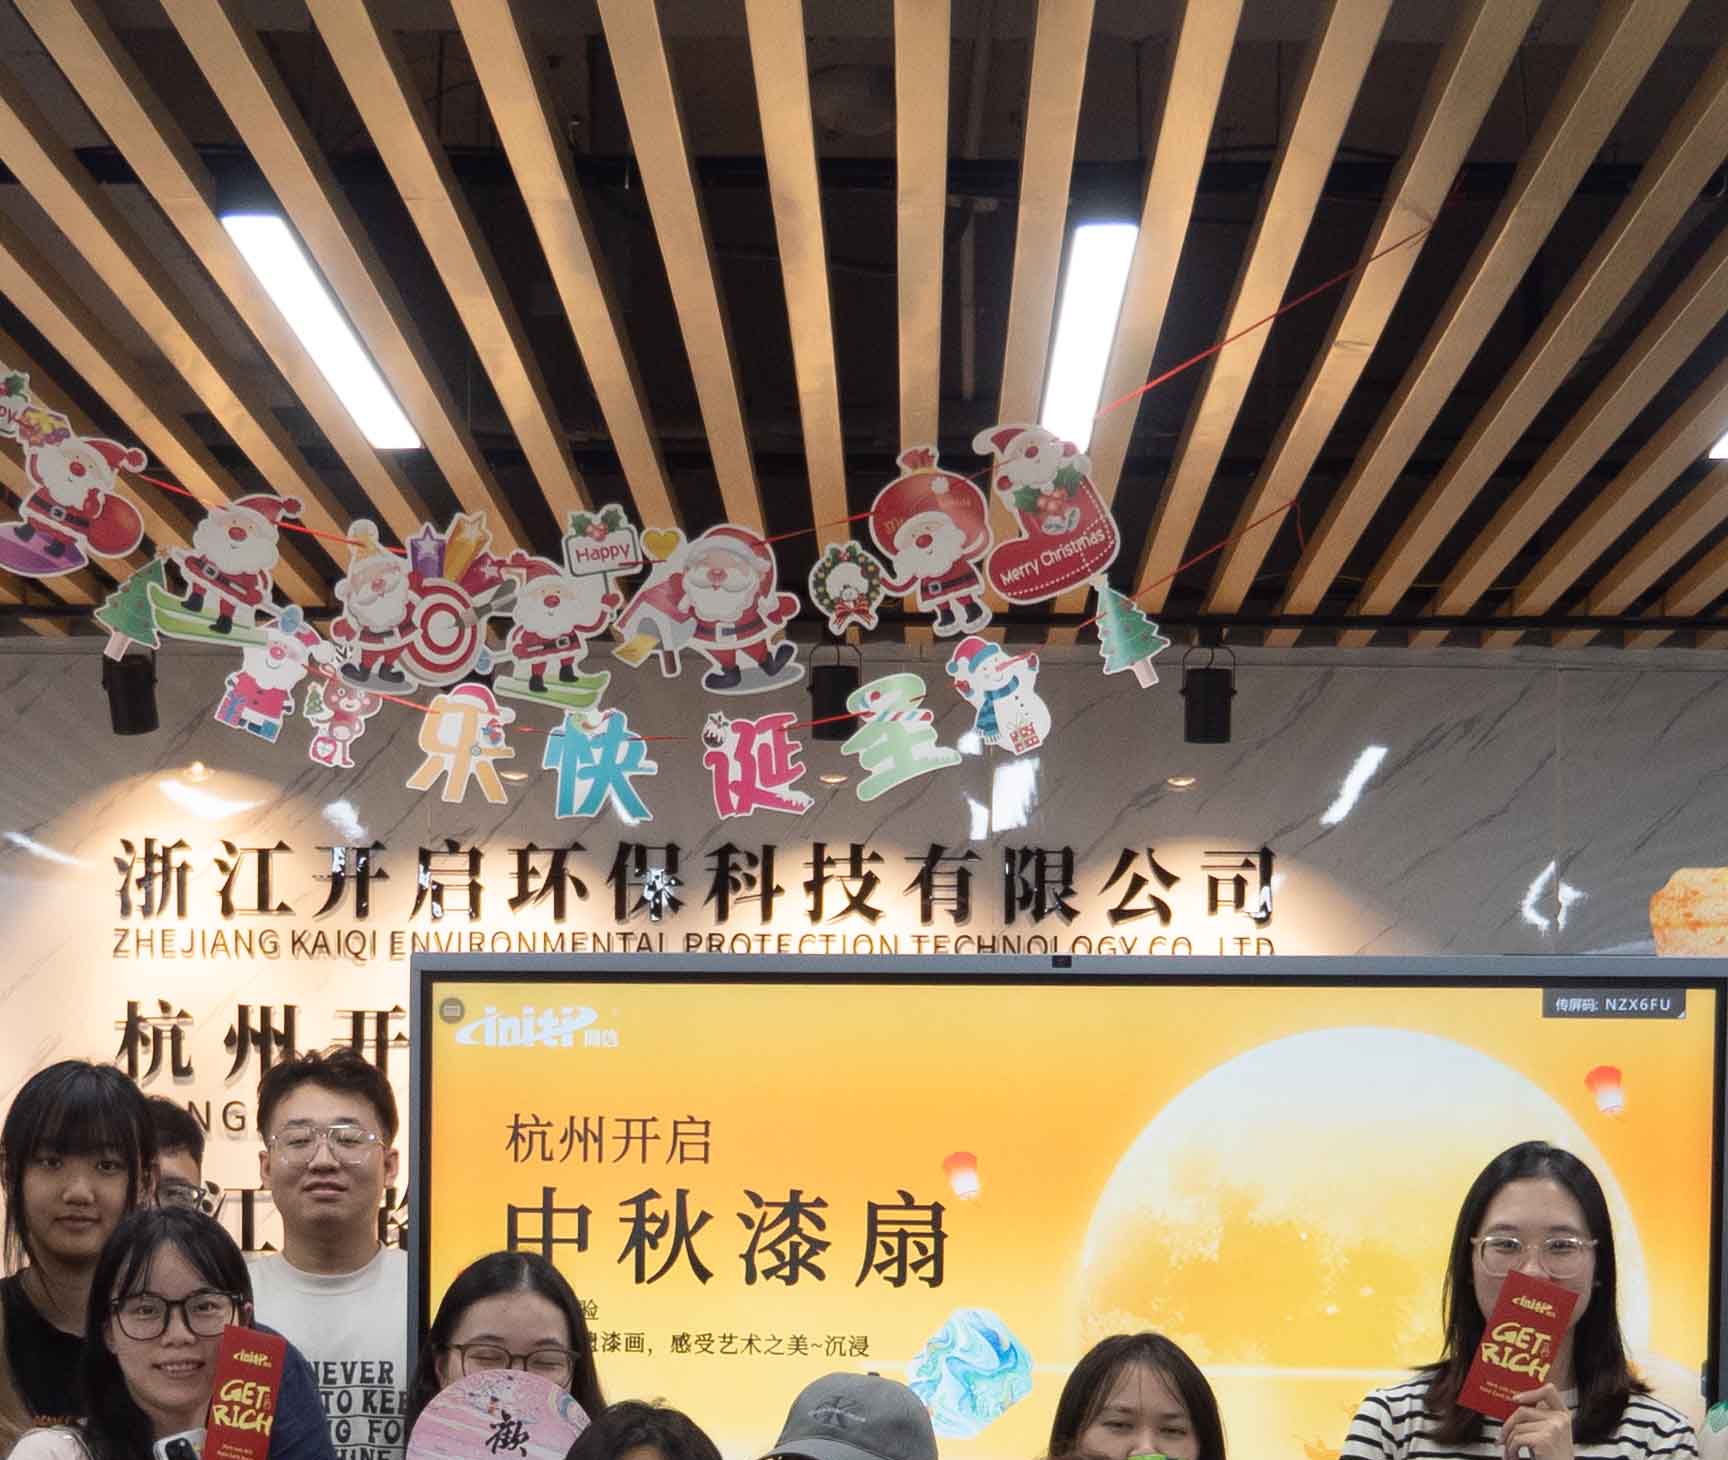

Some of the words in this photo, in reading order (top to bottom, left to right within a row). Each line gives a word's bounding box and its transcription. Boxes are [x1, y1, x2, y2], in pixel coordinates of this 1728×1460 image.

[576, 544, 630, 562] Happy
[1000, 555, 1041, 587] Merry
[1039, 527, 1106, 567] Christmas
[112, 838, 1278, 925] 浙江开启环保科技有限公司
[112, 929, 280, 959] ZHEJIANG
[290, 929, 380, 961] KAIQI
[1604, 997, 1672, 1012] NZX6FU
[505, 1112, 713, 1165] 杭州开启
[506, 1185, 950, 1289] 中秋漆扇
[1491, 1321, 1551, 1354] GET
[1481, 1342, 1551, 1382] RICH
[219, 1378, 271, 1409] GET
[212, 1403, 274, 1436] RICH
